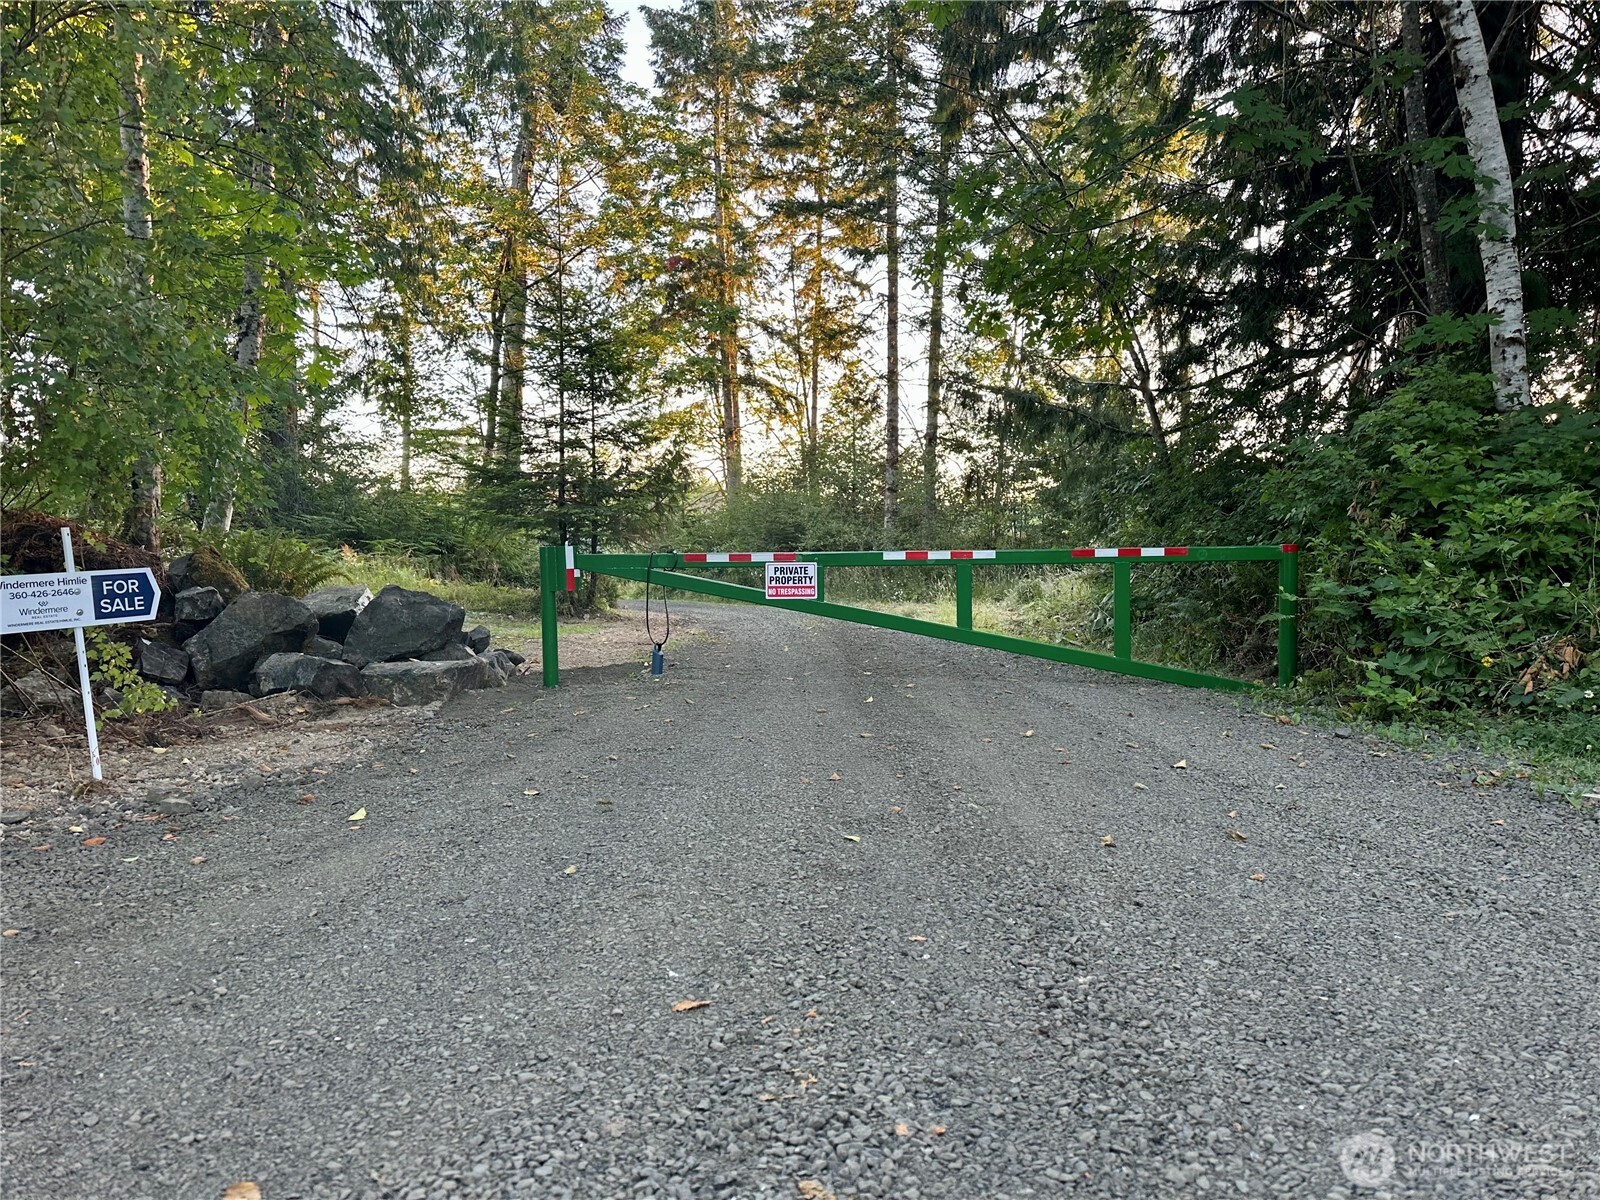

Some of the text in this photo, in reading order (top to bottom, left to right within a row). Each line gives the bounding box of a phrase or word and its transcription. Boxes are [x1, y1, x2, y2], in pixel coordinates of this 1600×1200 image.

[774, 566, 809, 575] PRIVATE
[57, 577, 87, 586] Himlie
[769, 576, 814, 585] PROPERTY
[102, 579, 140, 595] FOR
[9, 588, 75, 600] 360-426-2646
[100, 596, 145, 613] SALE
[19, 606, 69, 616] Windermere
